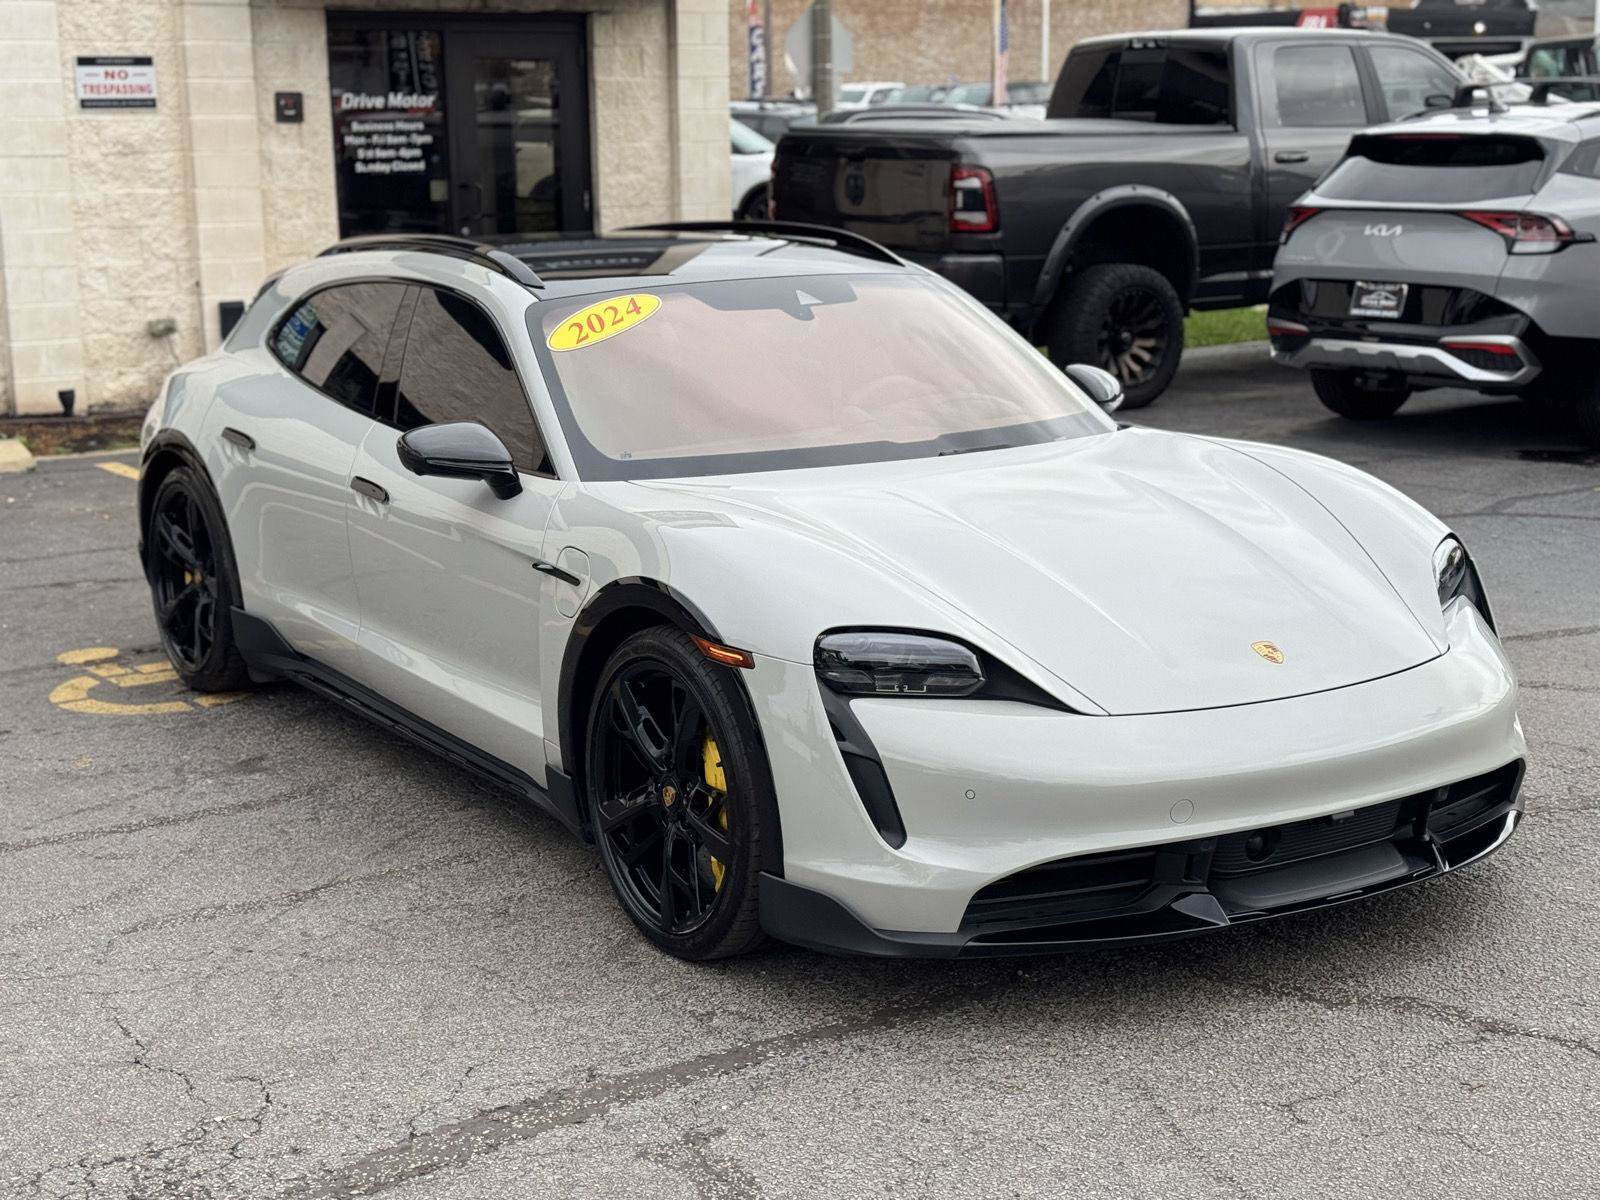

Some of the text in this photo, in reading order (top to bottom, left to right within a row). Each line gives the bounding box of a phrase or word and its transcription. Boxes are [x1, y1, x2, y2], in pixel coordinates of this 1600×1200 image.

[104, 70, 128, 79] NO
[83, 84, 153, 94] TRESPASSING
[341, 91, 436, 109] Drive Motor
[355, 160, 426, 174] Sunday Closed
[1363, 224, 1402, 236] KIA
[568, 297, 642, 345] 2024
